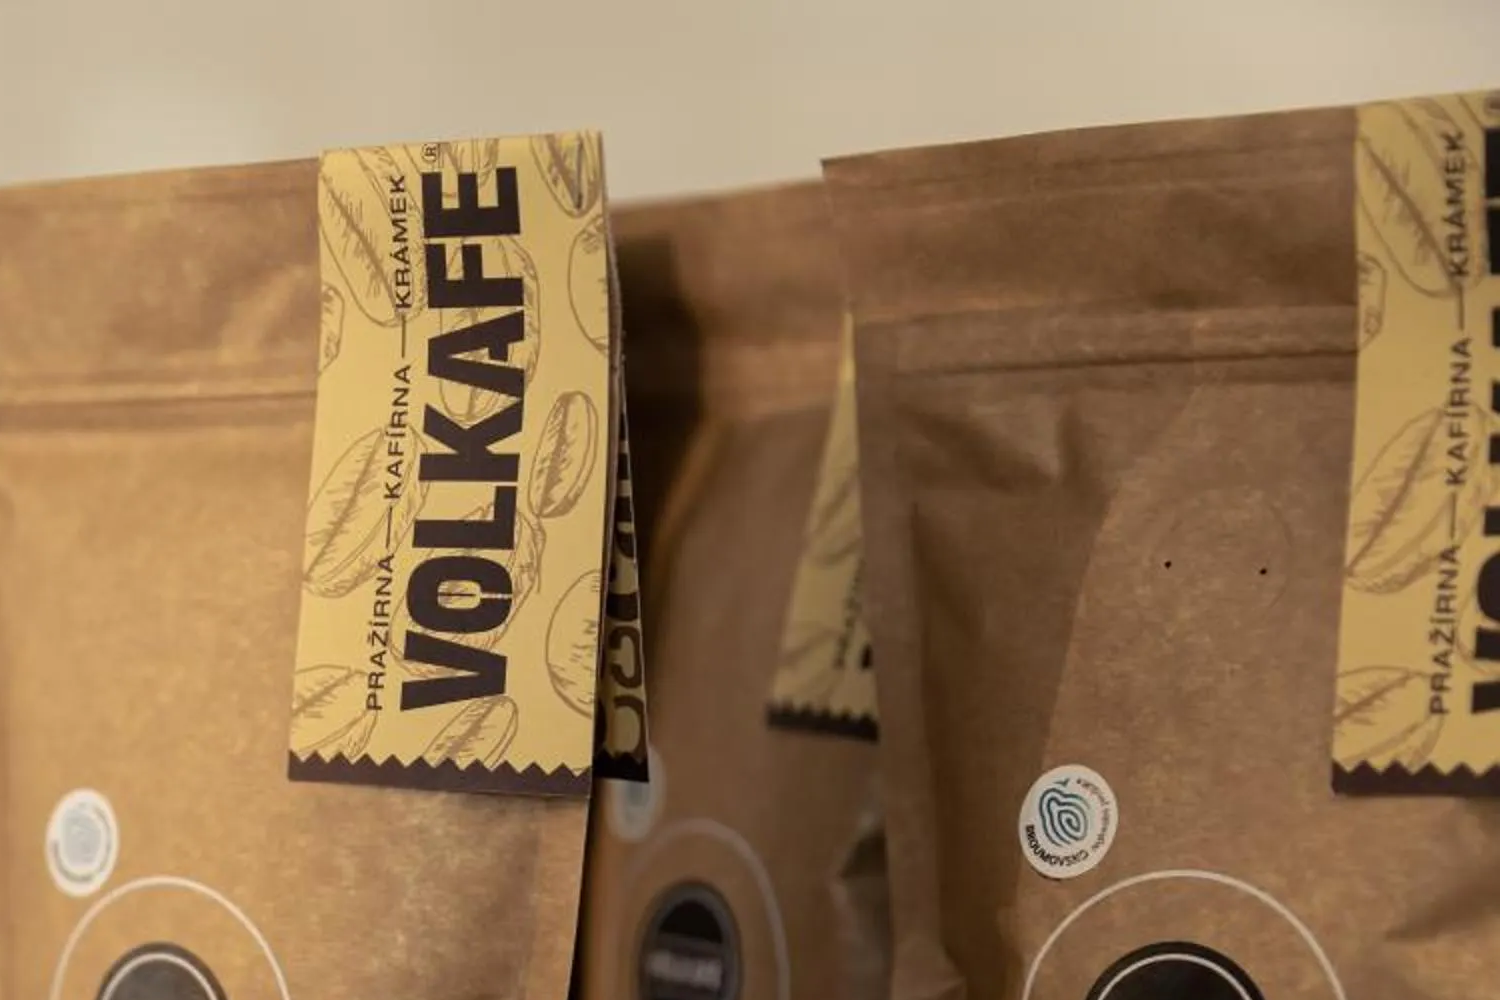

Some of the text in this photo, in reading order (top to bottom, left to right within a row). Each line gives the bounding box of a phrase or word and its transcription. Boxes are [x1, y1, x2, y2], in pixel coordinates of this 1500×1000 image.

[365, 174, 412, 712] PRAŽÍRNA KAFÍRNA KRÁMEK
[400, 166, 525, 712] VOLKAFE
[1428, 129, 1472, 715] PRAŽÍRNA KAFÍRNA KRÁMEK
